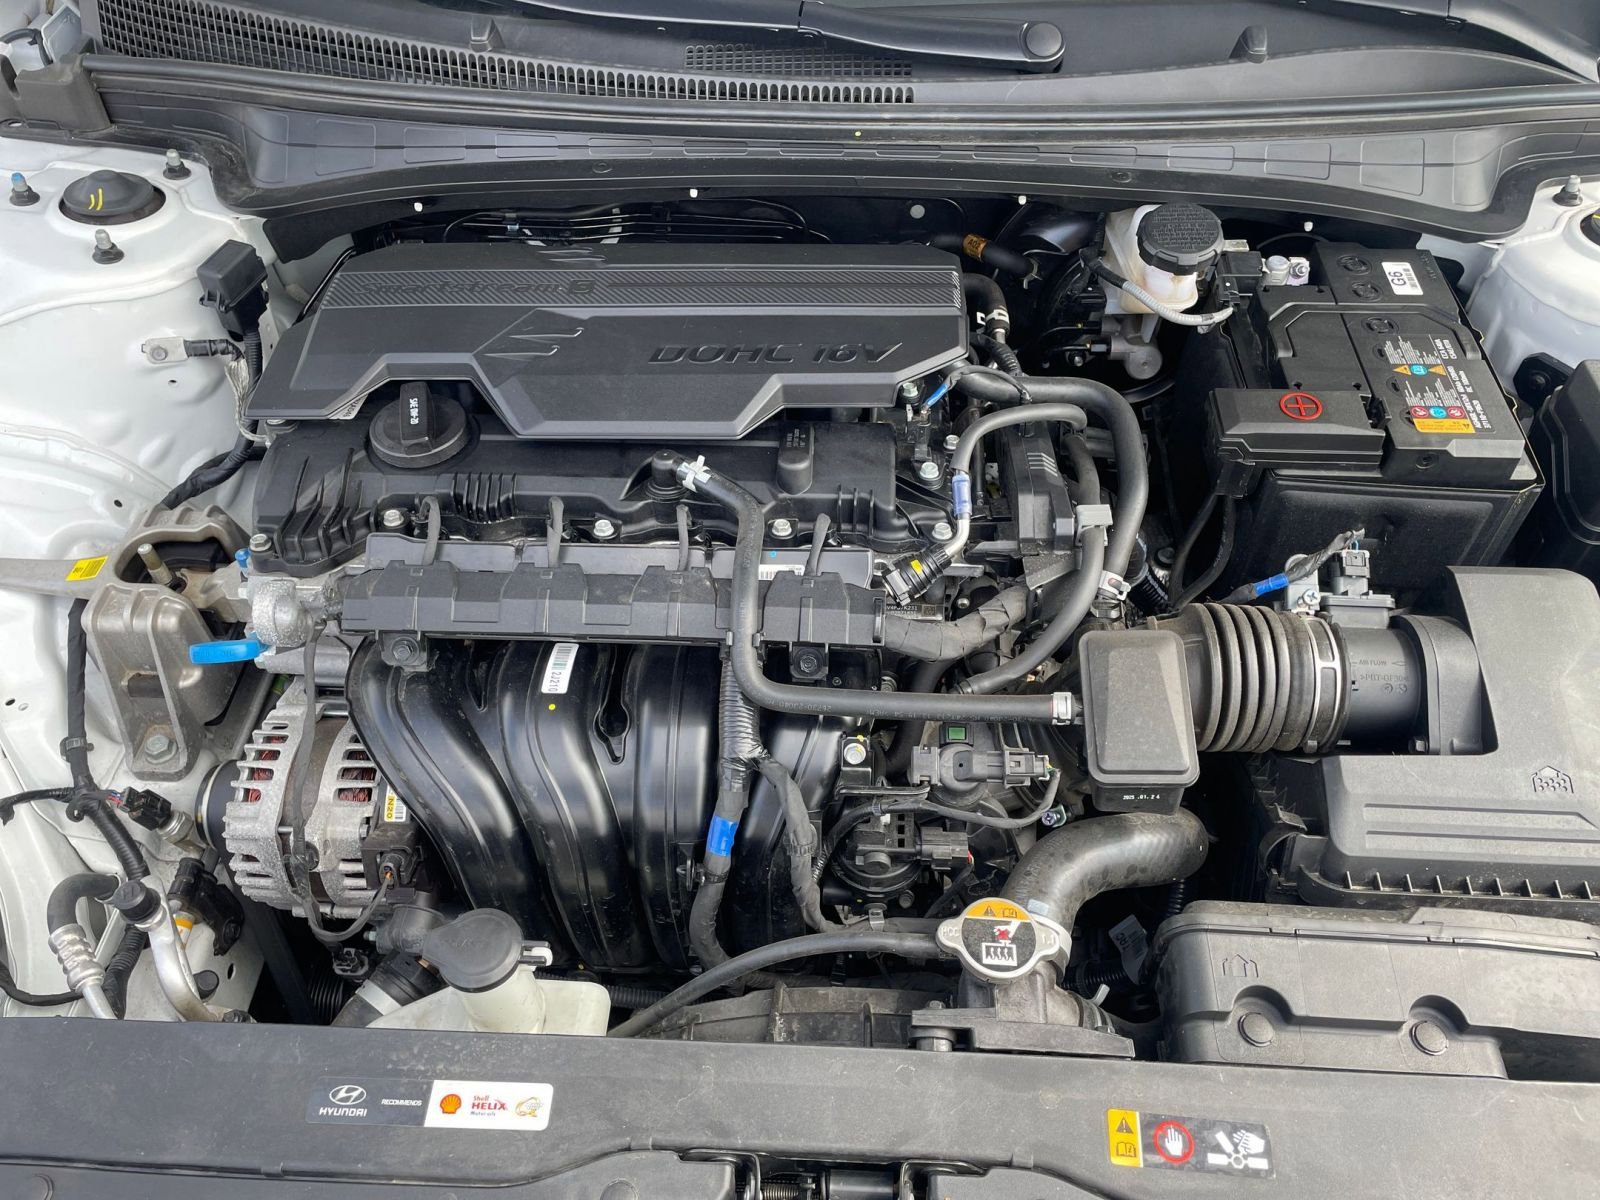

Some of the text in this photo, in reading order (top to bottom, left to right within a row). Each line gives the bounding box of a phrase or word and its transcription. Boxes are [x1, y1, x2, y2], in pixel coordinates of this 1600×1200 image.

[1388, 271, 1406, 286] G6
[648, 342, 903, 364] DOHC 16V
[409, 397, 419, 408] SAE
[387, 798, 395, 819] N20
[381, 1099, 422, 1107] RECOMMENDS
[471, 1100, 507, 1111] HELIX
[318, 1107, 368, 1117] HYUNDAI
